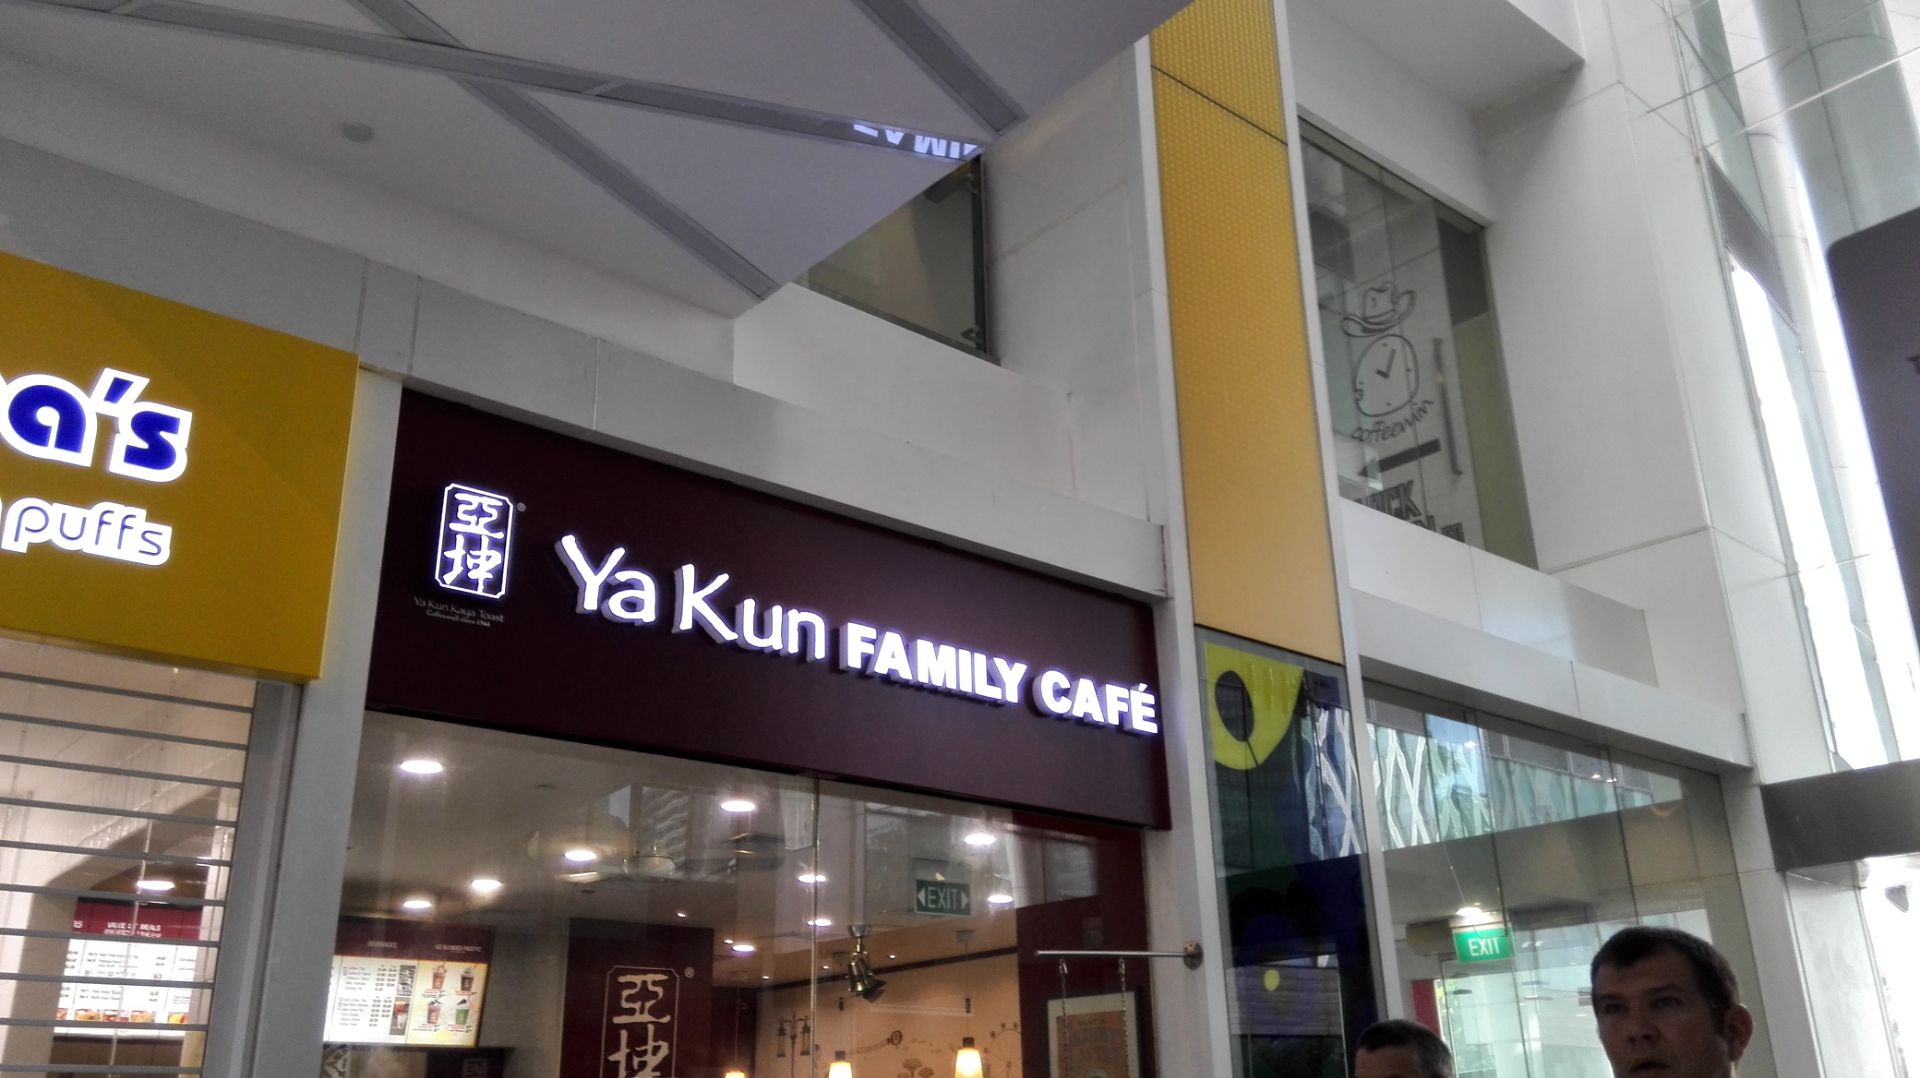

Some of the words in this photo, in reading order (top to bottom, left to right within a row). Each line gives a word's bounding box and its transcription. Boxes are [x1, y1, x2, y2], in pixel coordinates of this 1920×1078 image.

[0, 368, 192, 482] a's
[3, 498, 172, 565] puffs
[427, 599, 449, 612] Kun
[479, 609, 505, 623] Toast
[556, 534, 657, 625] Ya
[673, 563, 826, 661] Kun
[842, 621, 1028, 704] FAMILY
[1035, 670, 1158, 735] CAFÉ
[927, 886, 959, 910] EXIT
[1467, 937, 1501, 957] EXIT
